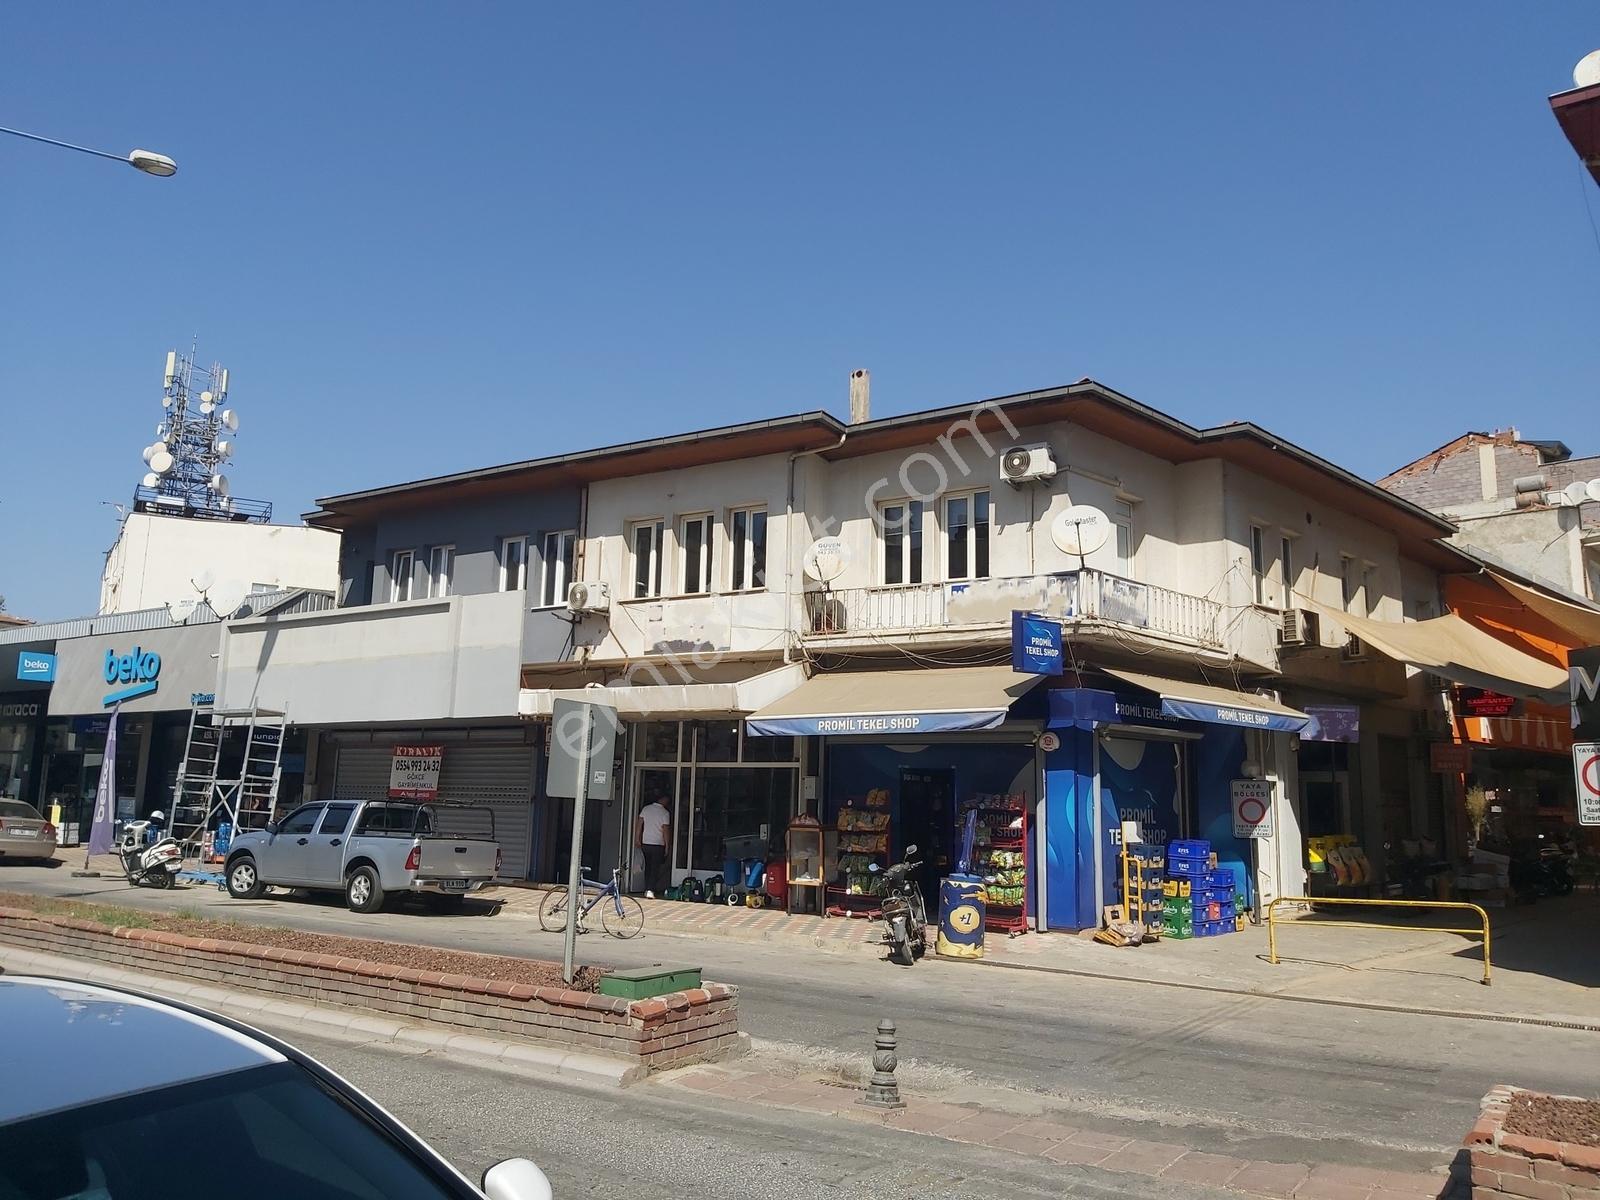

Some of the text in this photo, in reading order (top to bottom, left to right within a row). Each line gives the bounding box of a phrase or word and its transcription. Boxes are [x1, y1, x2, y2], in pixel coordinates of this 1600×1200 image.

[1025, 645, 1060, 657] TEKEL SHOP
[24, 659, 49, 669] beko
[105, 646, 160, 684] beko
[818, 717, 920, 731] PROMİL TEKEL SHOP
[1238, 712, 1255, 724] TEKEL
[1254, 714, 1270, 726] SHOP
[396, 760, 440, 772] 0554 993 24 32
[96, 758, 109, 823] beko
